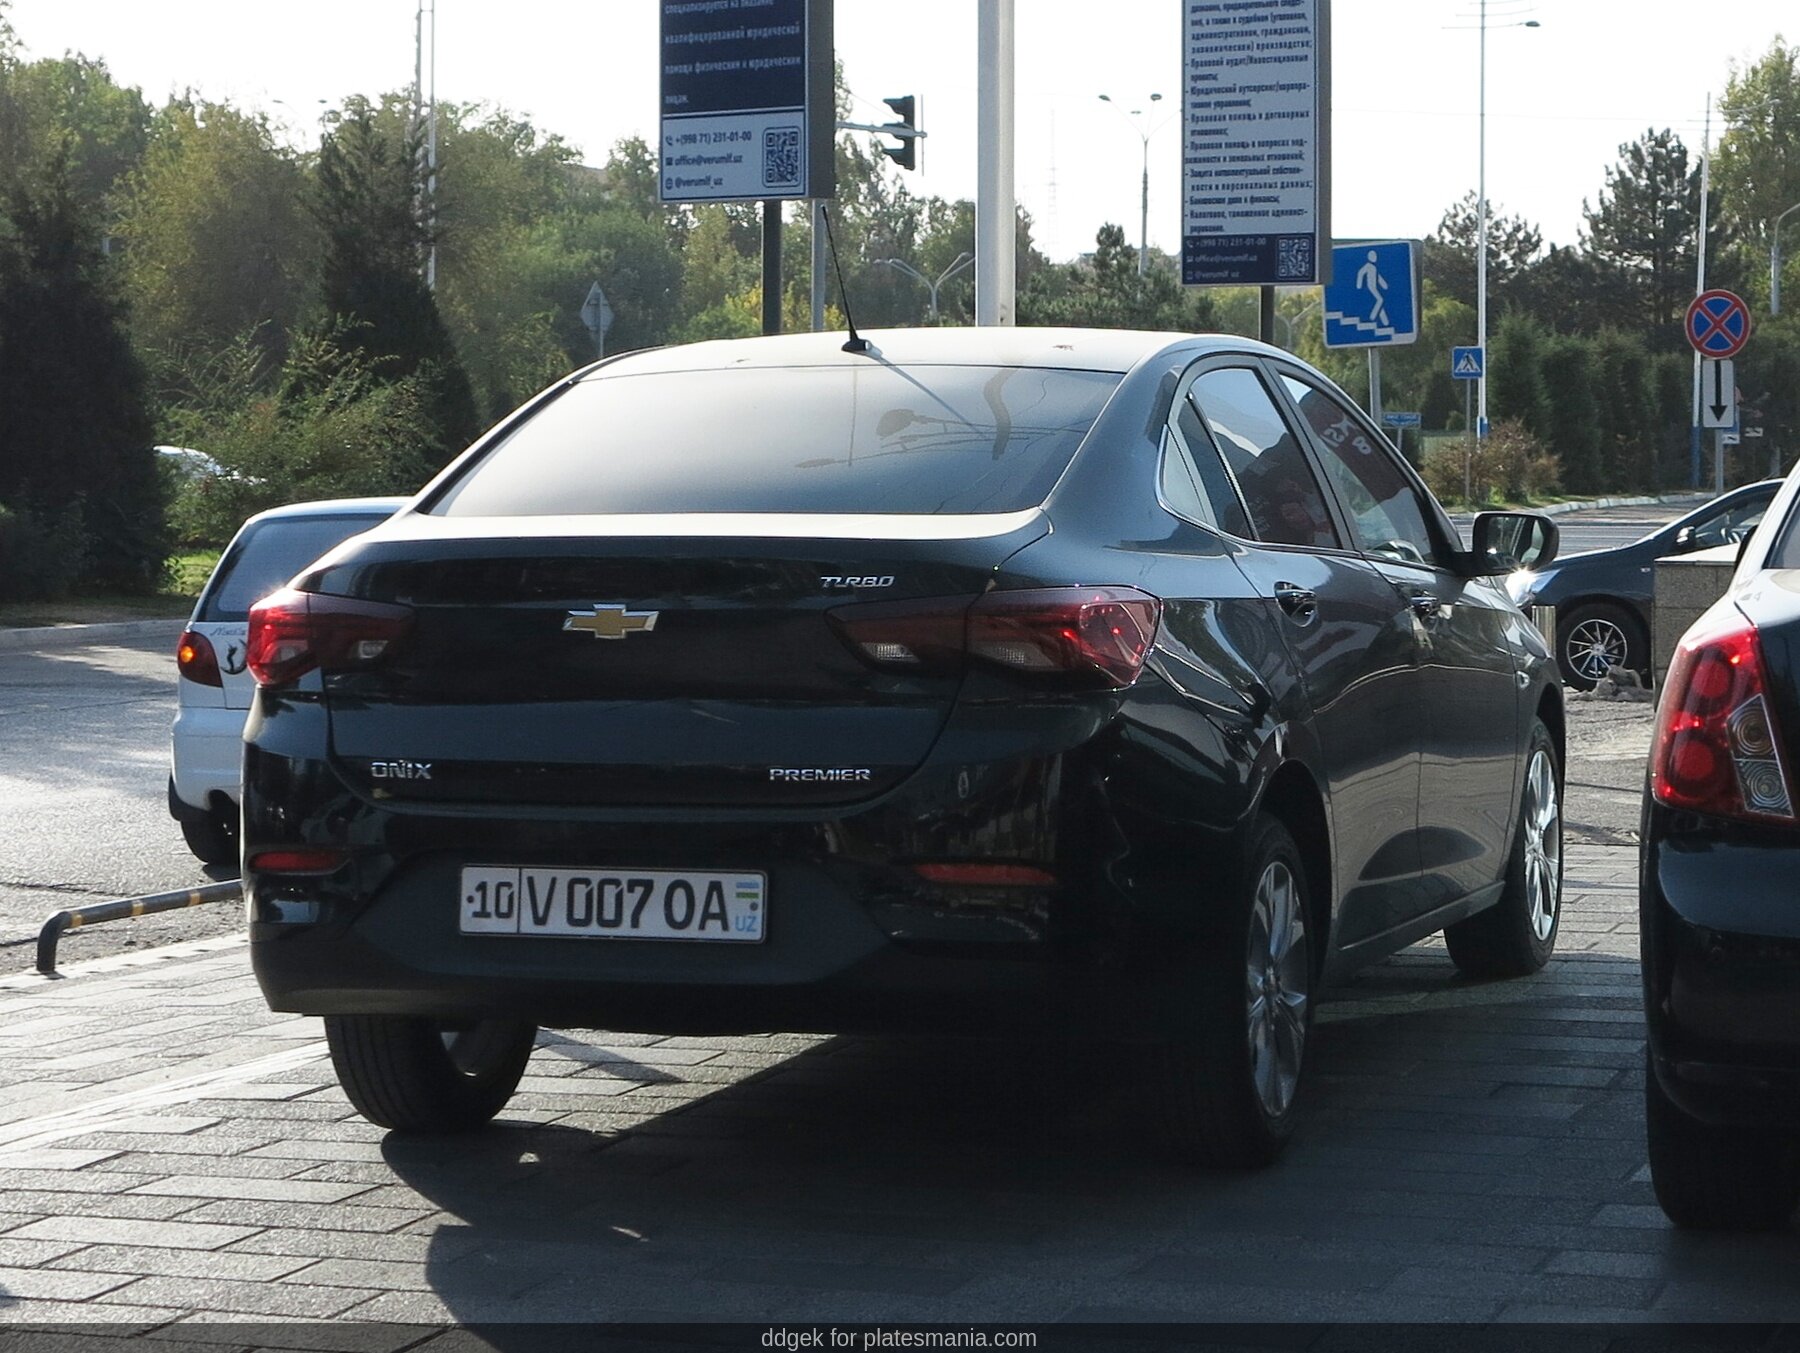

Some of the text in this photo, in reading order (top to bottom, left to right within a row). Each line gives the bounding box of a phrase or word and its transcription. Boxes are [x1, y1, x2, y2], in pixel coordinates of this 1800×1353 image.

[665, 22, 800, 44] квалифицированной юридической
[695, 61, 740, 74] физическим
[742, 60, 747, 68] и
[749, 57, 800, 71] юридическим
[713, 131, 752, 143] 231-01-00
[820, 576, 895, 588] TURBO
[371, 760, 432, 779] ONIX
[769, 768, 871, 781] PREMIER
[472, 881, 515, 919] 10
[735, 915, 758, 932] UZ
